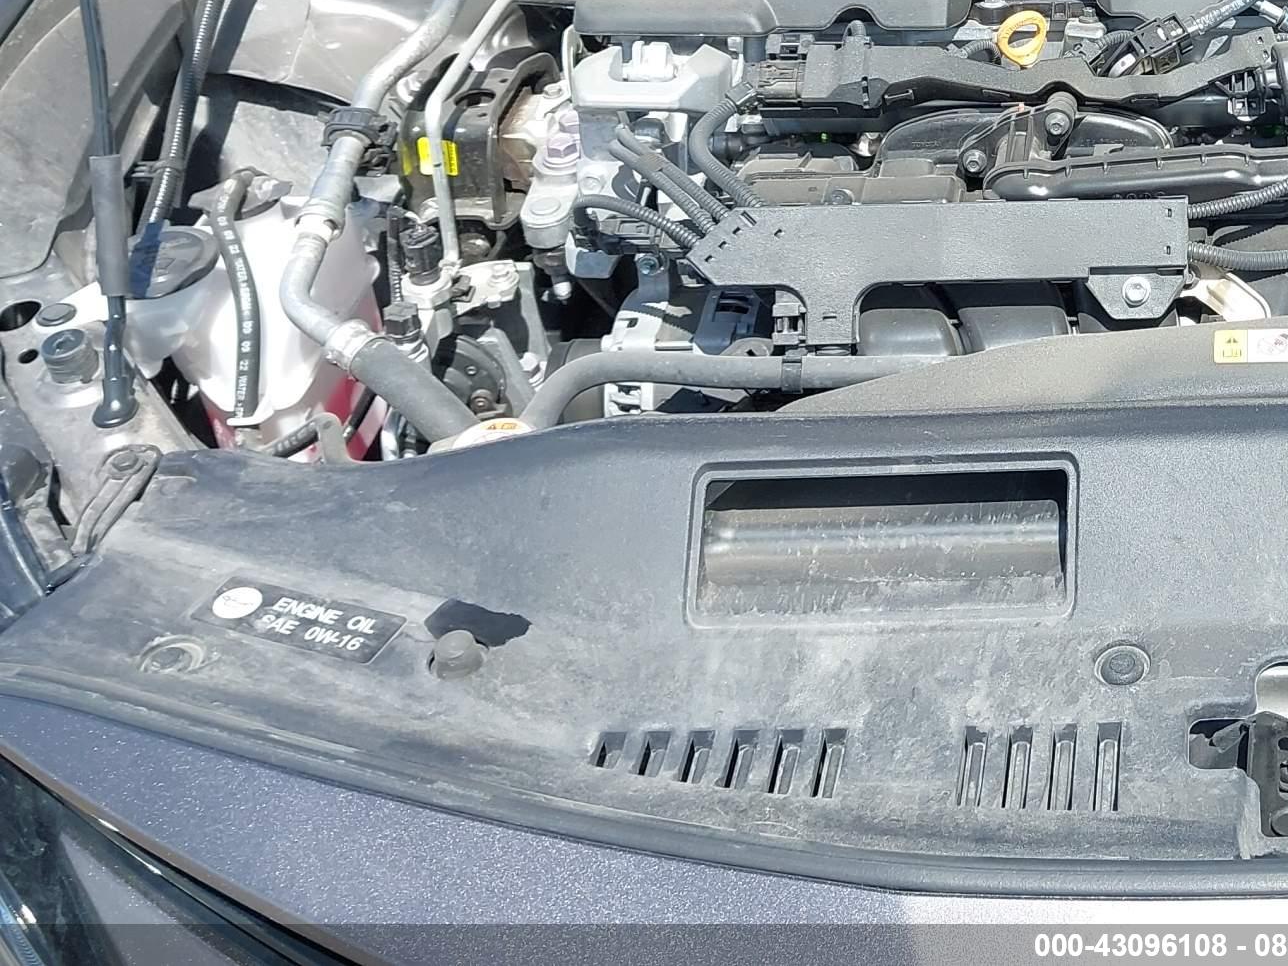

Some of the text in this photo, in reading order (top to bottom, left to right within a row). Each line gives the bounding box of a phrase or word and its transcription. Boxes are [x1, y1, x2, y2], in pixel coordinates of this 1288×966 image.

[257, 614, 364, 651] SAE 0W-16
[271, 596, 376, 634] ENGINE OIL
